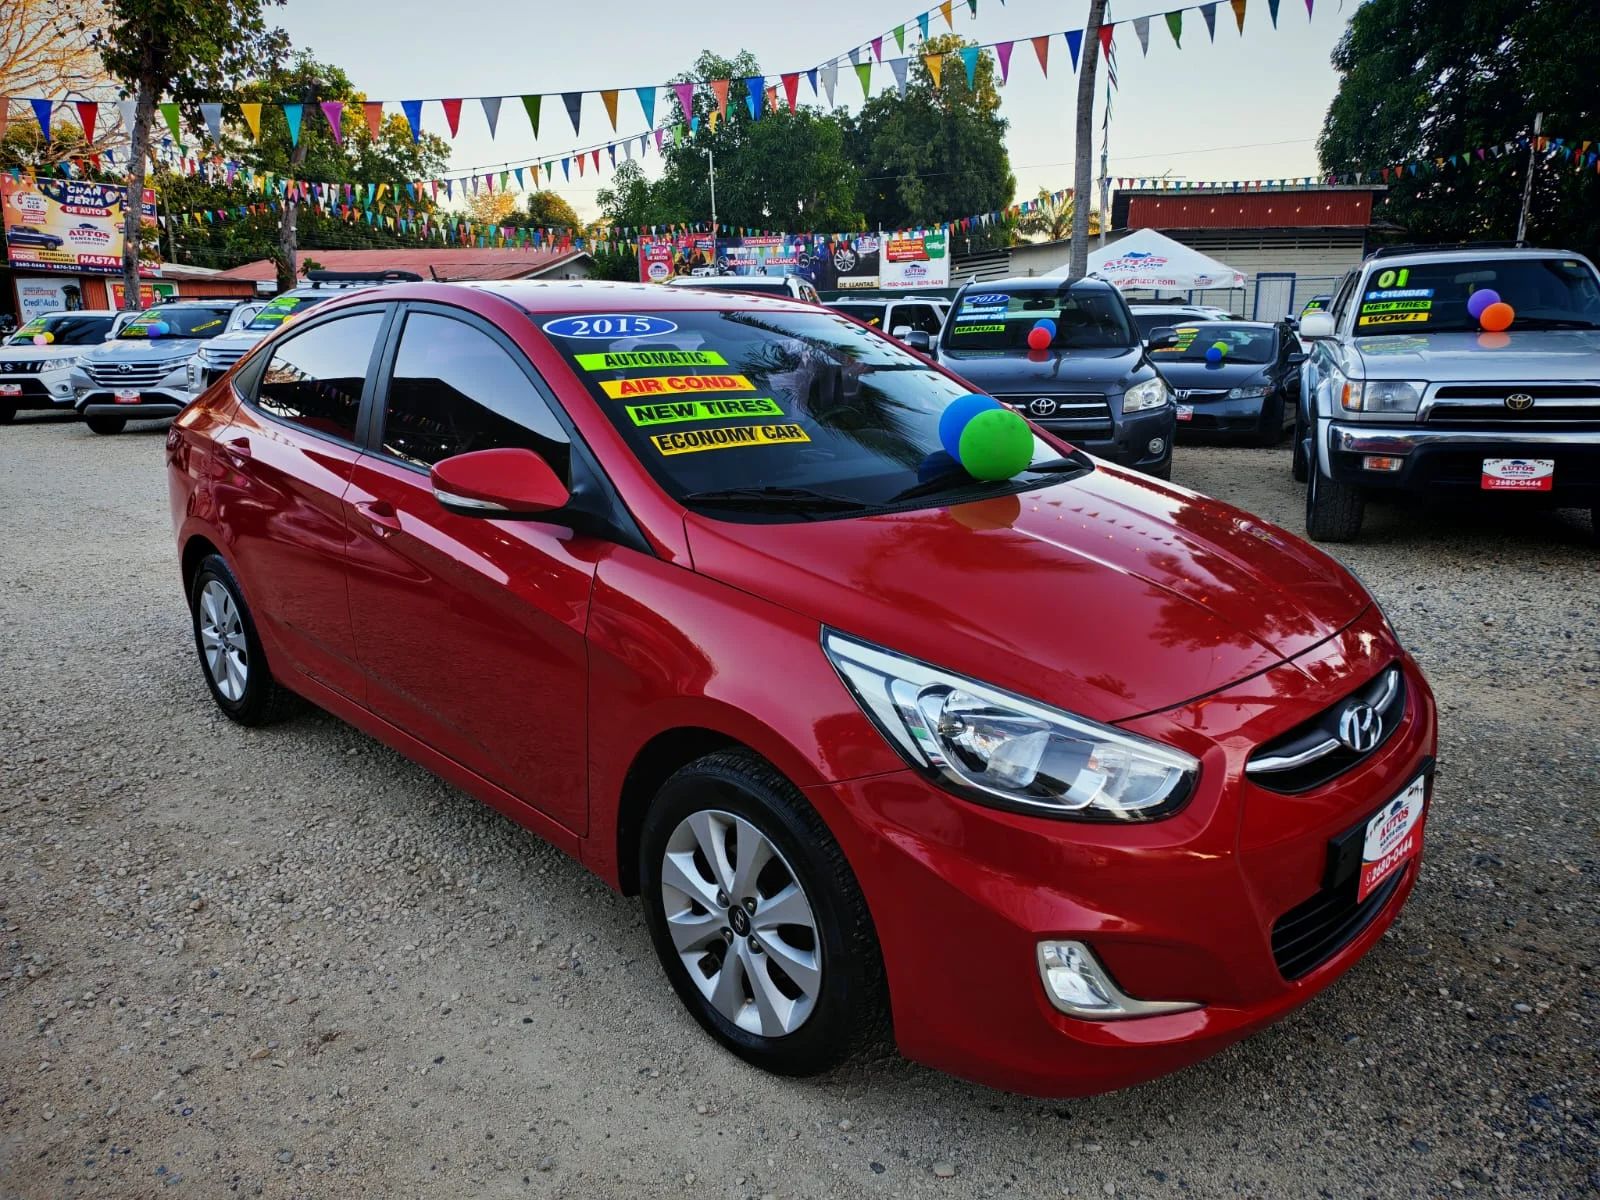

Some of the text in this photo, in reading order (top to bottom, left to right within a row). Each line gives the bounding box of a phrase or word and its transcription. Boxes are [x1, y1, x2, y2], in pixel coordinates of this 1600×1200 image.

[67, 185, 102, 196] GRAN
[66, 195, 104, 206] FERIA
[80, 207, 107, 216] AUTOS
[69, 230, 110, 239] AUTOS
[80, 255, 117, 266] HASTA
[1378, 268, 1409, 288] 01
[1369, 288, 1430, 299] 6-CYLINDER
[1365, 301, 1429, 311] NEW TIRES
[1367, 314, 1409, 323] WOW
[572, 318, 651, 336] 2015
[955, 325, 1004, 333] MANUAL
[604, 351, 708, 367] AUTOMATIC
[620, 376, 742, 395] AIR COND.
[636, 399, 774, 422] NEW TIRES
[656, 424, 803, 451] ECONOMY CAR
[1495, 479, 1542, 487] 2680-0444
[1379, 806, 1409, 840] AUTOS
[1371, 835, 1413, 882] 2680-0444
